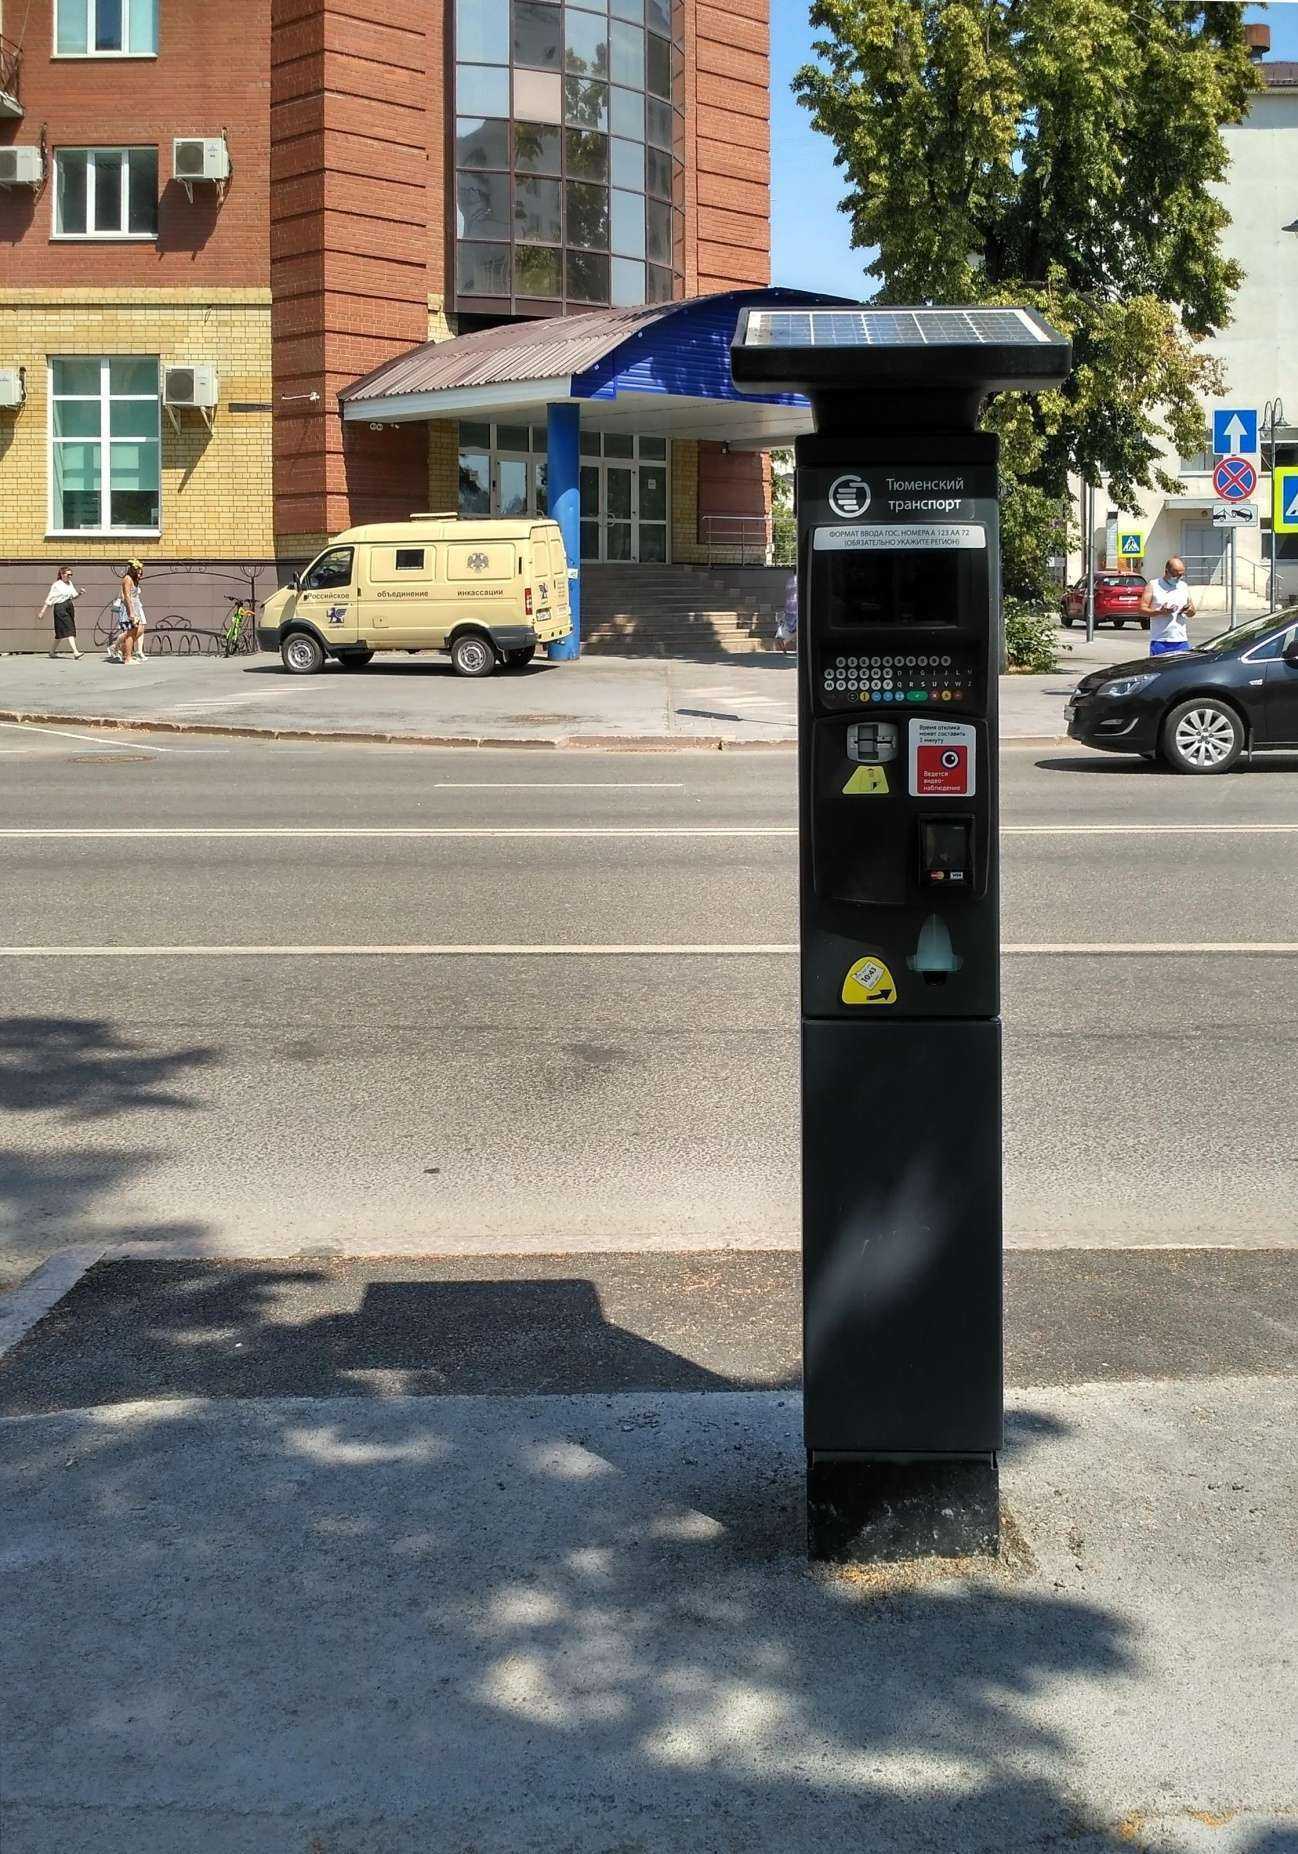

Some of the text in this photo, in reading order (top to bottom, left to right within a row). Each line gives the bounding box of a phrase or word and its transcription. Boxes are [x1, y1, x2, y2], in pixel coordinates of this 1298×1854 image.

[886, 477, 964, 491] Тюменский
[888, 499, 962, 513] транспорт
[829, 530, 859, 538] ФОРМАТ
[860, 530, 884, 538] ВВОДА
[901, 529, 930, 537] НОМЕРА
[844, 539, 896, 547] (ОБЯЗАТЕЛЬНО
[896, 538, 929, 546] УКАЖИТЕ
[307, 589, 504, 600] Российское объединение инкассации
